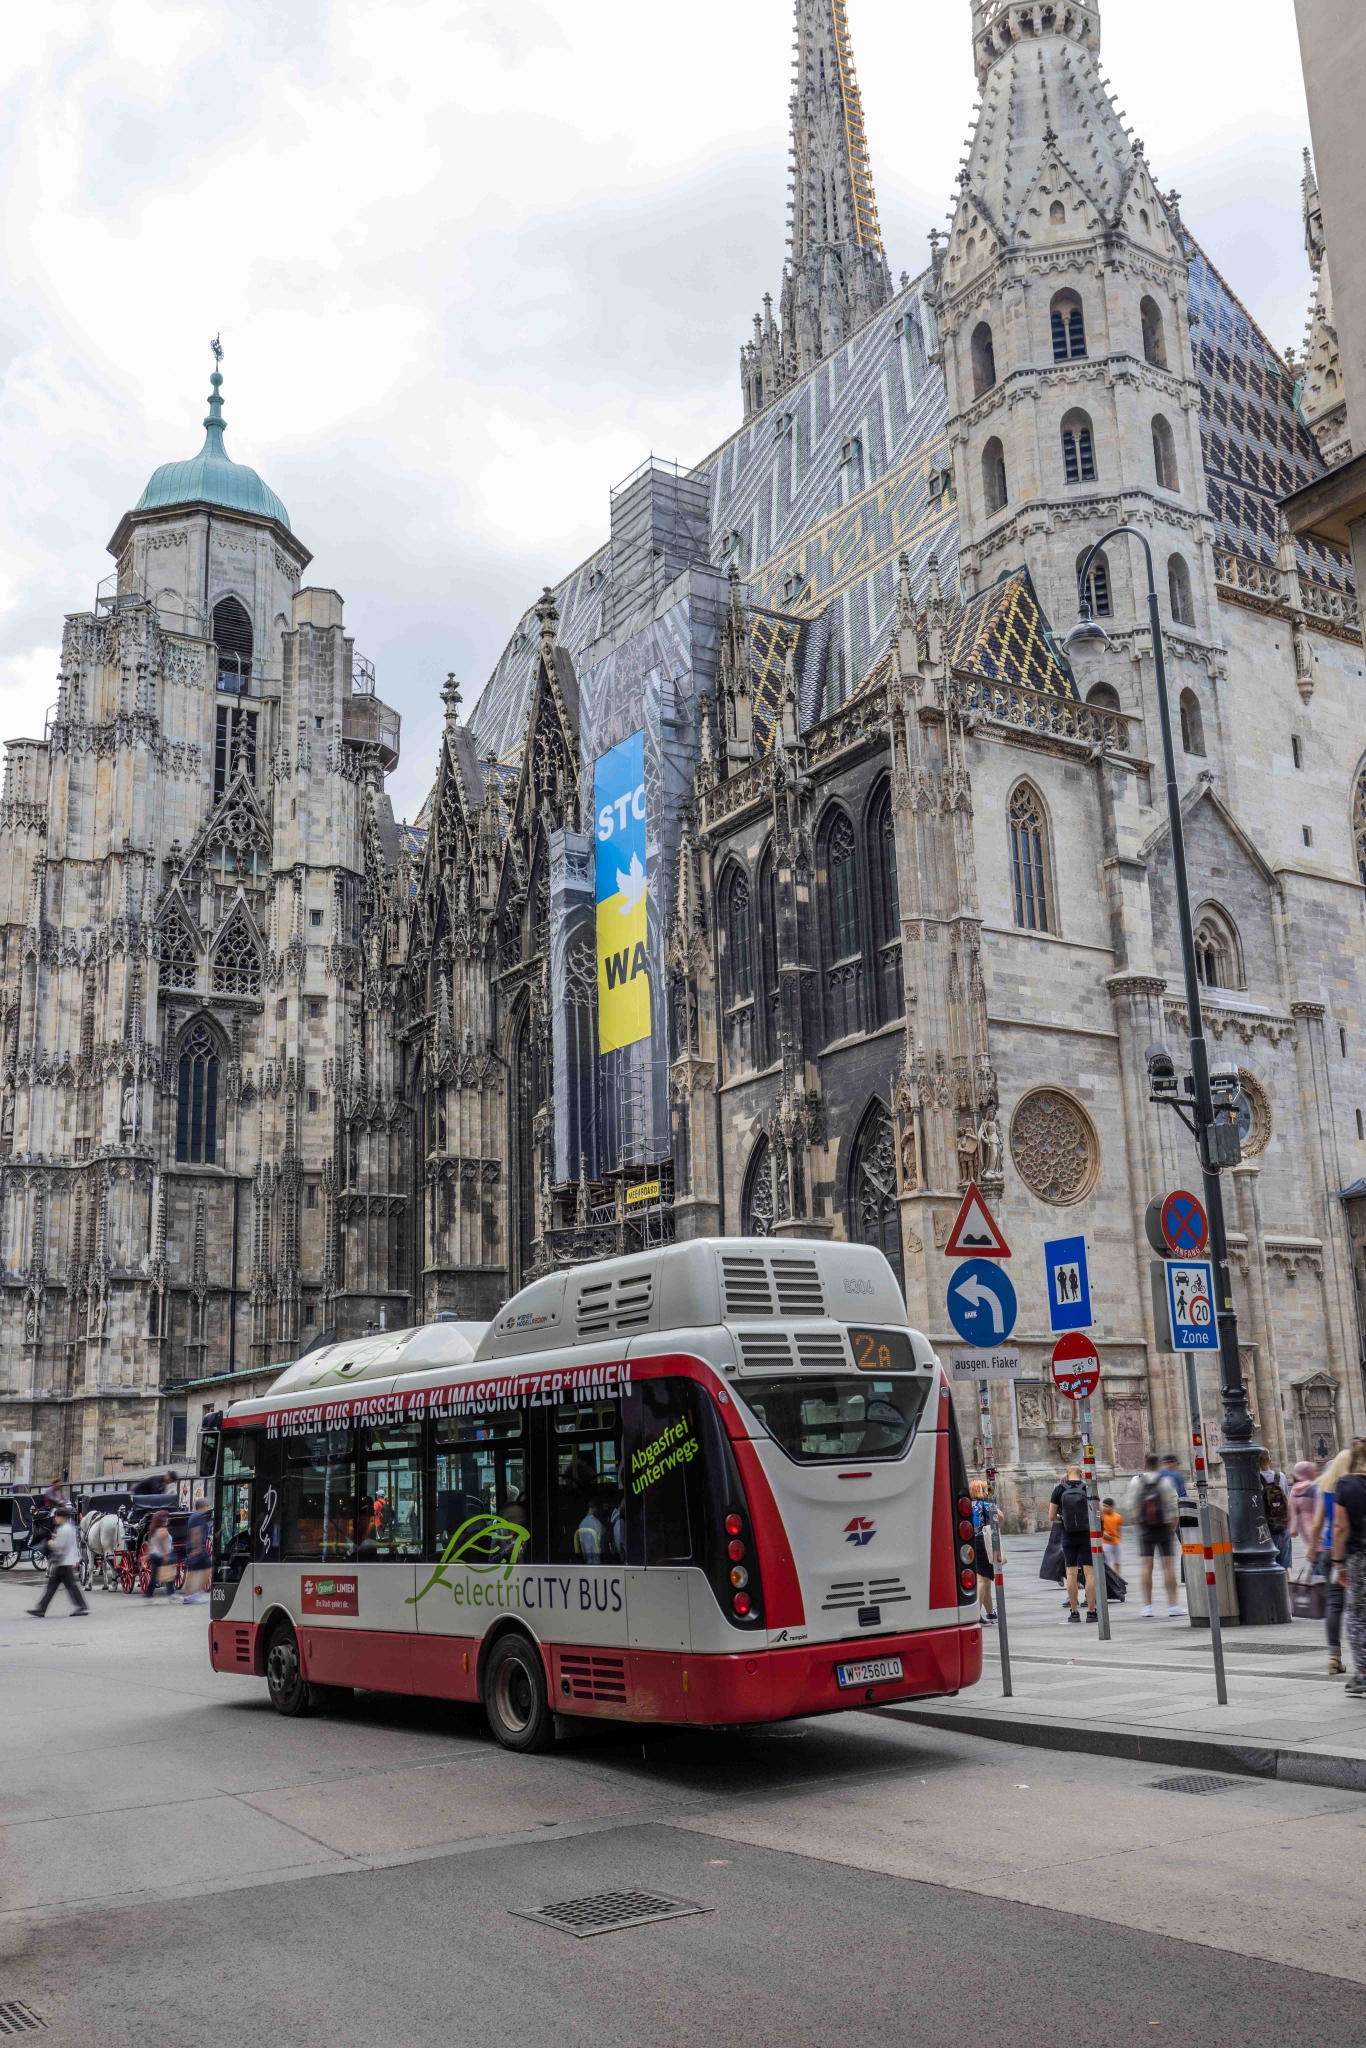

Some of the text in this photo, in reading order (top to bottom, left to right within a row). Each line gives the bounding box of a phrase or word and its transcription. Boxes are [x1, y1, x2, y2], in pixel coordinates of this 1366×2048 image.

[605, 940, 650, 991] WA
[1174, 1244, 1201, 1259] ANFANG
[843, 1278, 874, 1295] 8306
[1195, 1304, 1208, 1321] 20
[516, 1316, 548, 1328] MODELLREGION
[1181, 1329, 1209, 1344] Zone
[855, 1334, 891, 1367] 2A
[955, 1356, 1018, 1372] ausgen. Fiaker
[266, 1413, 279, 1440] IN
[281, 1406, 323, 1438] DIESEN
[325, 1402, 350, 1431] BUS
[353, 1394, 405, 1429] PASSEN
[408, 1392, 425, 1422] 40
[631, 1415, 689, 1473] Abgasfrei
[632, 1437, 699, 1495] unterwegs
[212, 1588, 225, 1601] 8306
[336, 1583, 355, 1593] LINIEN
[453, 1575, 622, 1612] electriCITY BUS
[789, 1633, 808, 1641] rampini
[862, 1663, 886, 1680] 2560
